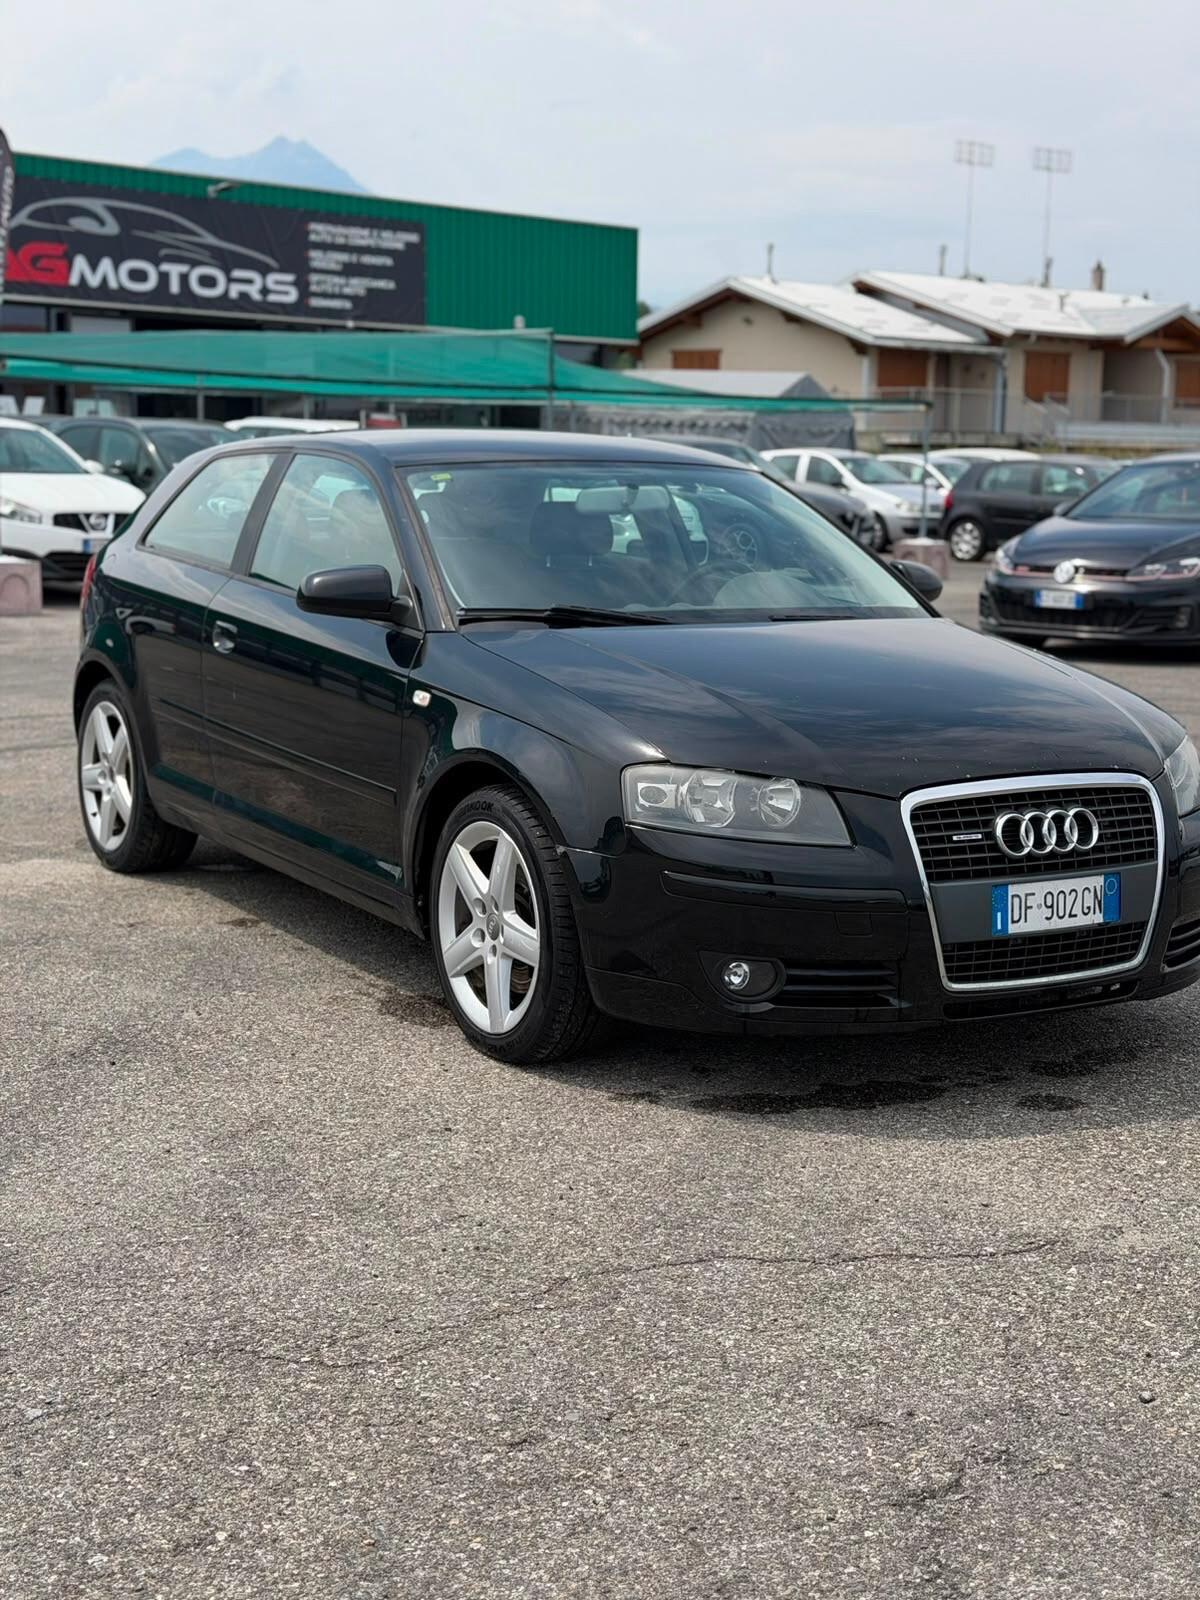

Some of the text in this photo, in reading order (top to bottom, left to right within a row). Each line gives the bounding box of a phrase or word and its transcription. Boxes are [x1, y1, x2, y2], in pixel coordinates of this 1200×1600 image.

[69, 254, 299, 304] MOTORS
[1010, 892, 1036, 925] DF
[1043, 884, 1104, 921] 902GN
